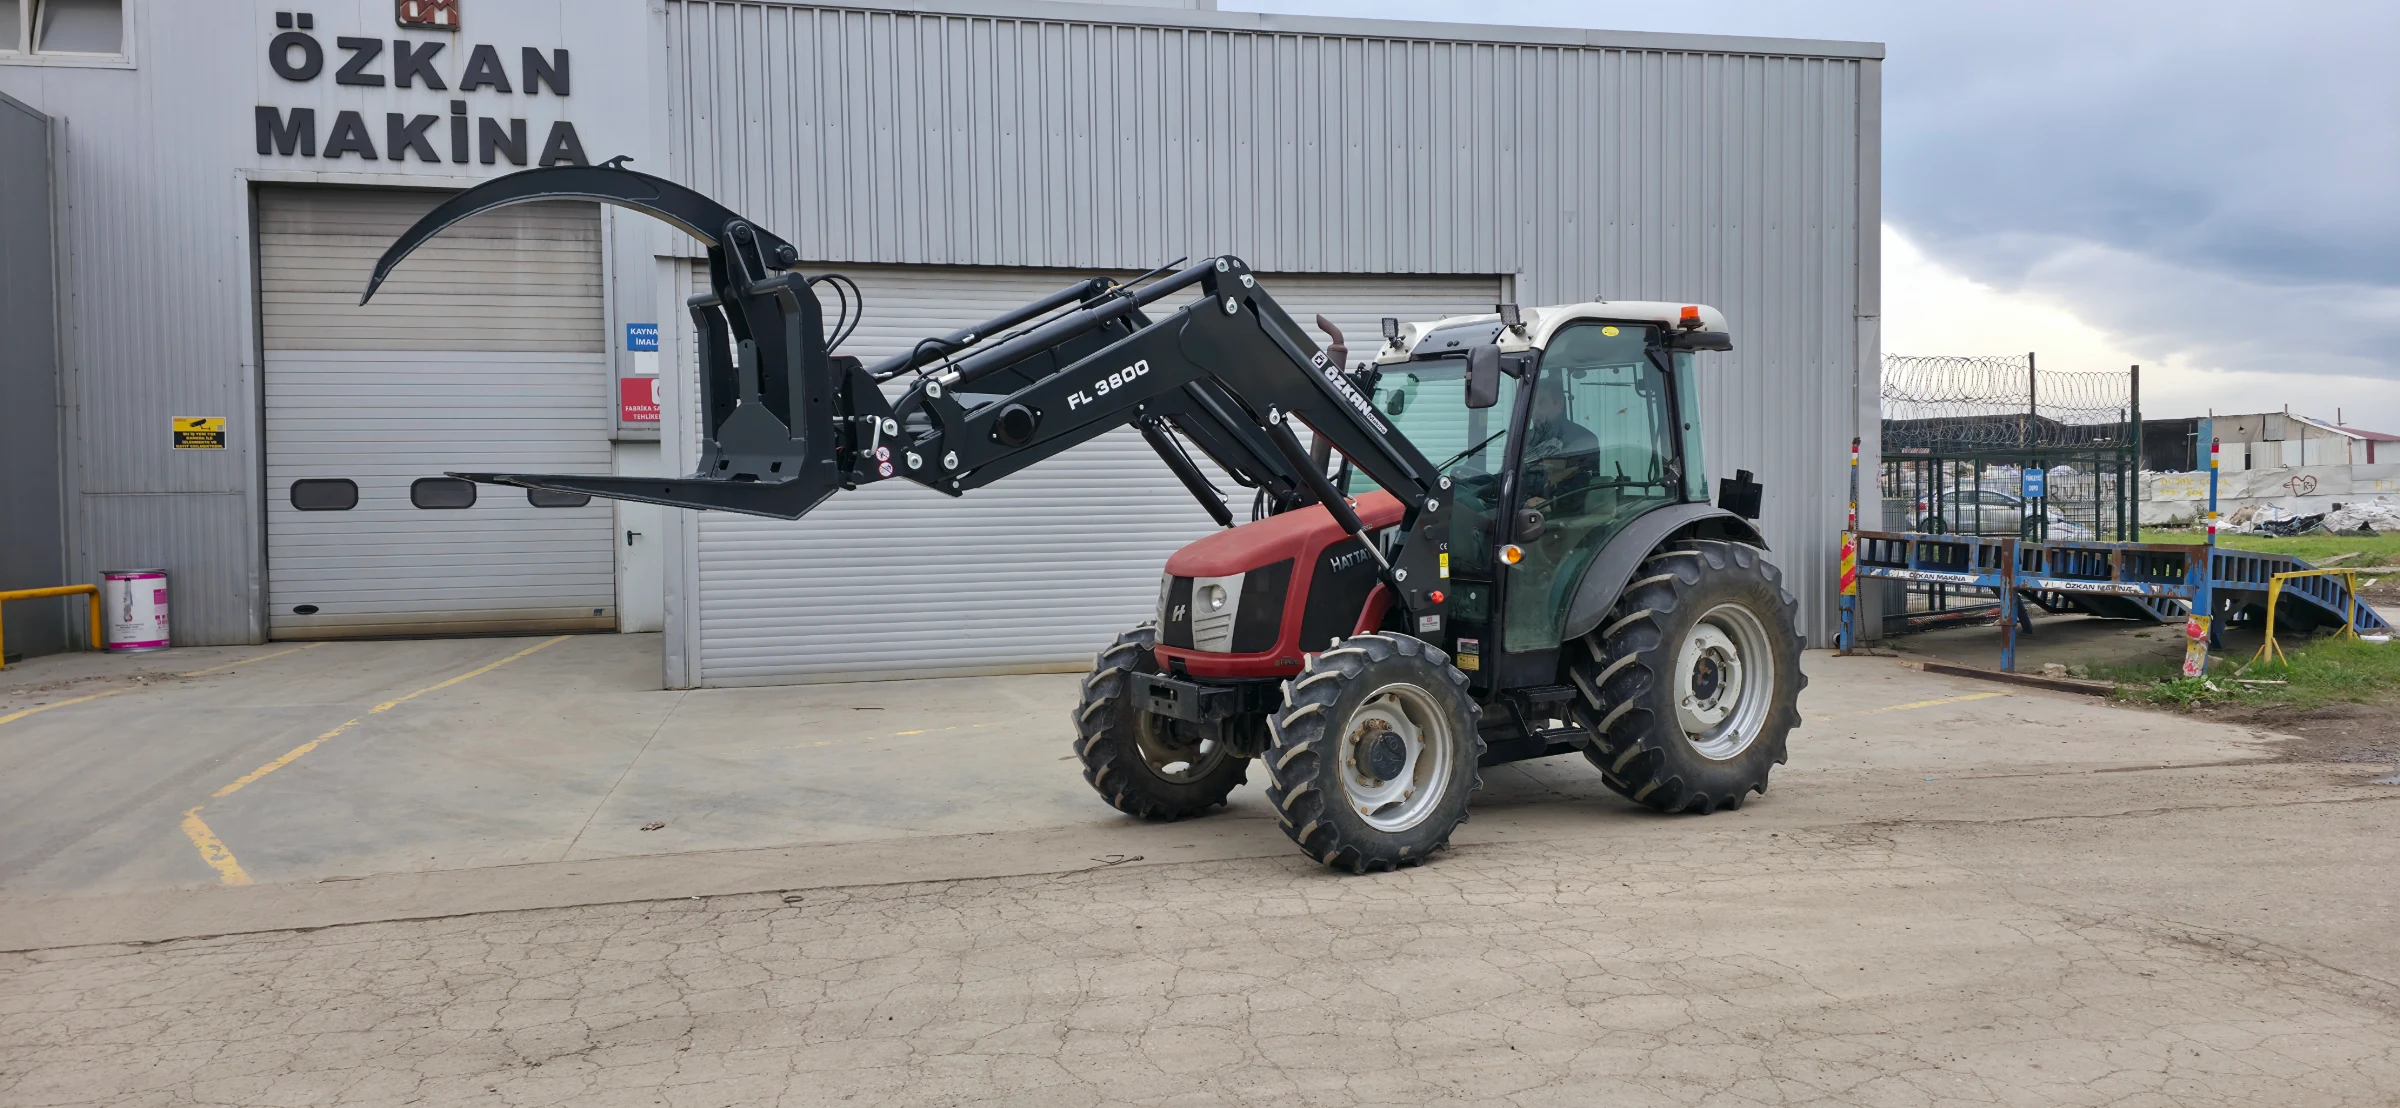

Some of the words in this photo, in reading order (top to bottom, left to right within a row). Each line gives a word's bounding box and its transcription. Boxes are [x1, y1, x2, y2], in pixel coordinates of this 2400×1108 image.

[269, 12, 570, 96] ÖZKAN
[255, 100, 590, 167] MAKİNA
[625, 404, 652, 412] FABRİKA
[1067, 390, 1093, 411] FL
[1095, 359, 1149, 396] 3800
[1324, 365, 1373, 417] ÖZKAN
[1367, 413, 1387, 434] Makina
[2065, 582, 2095, 590] ÖZKAN
